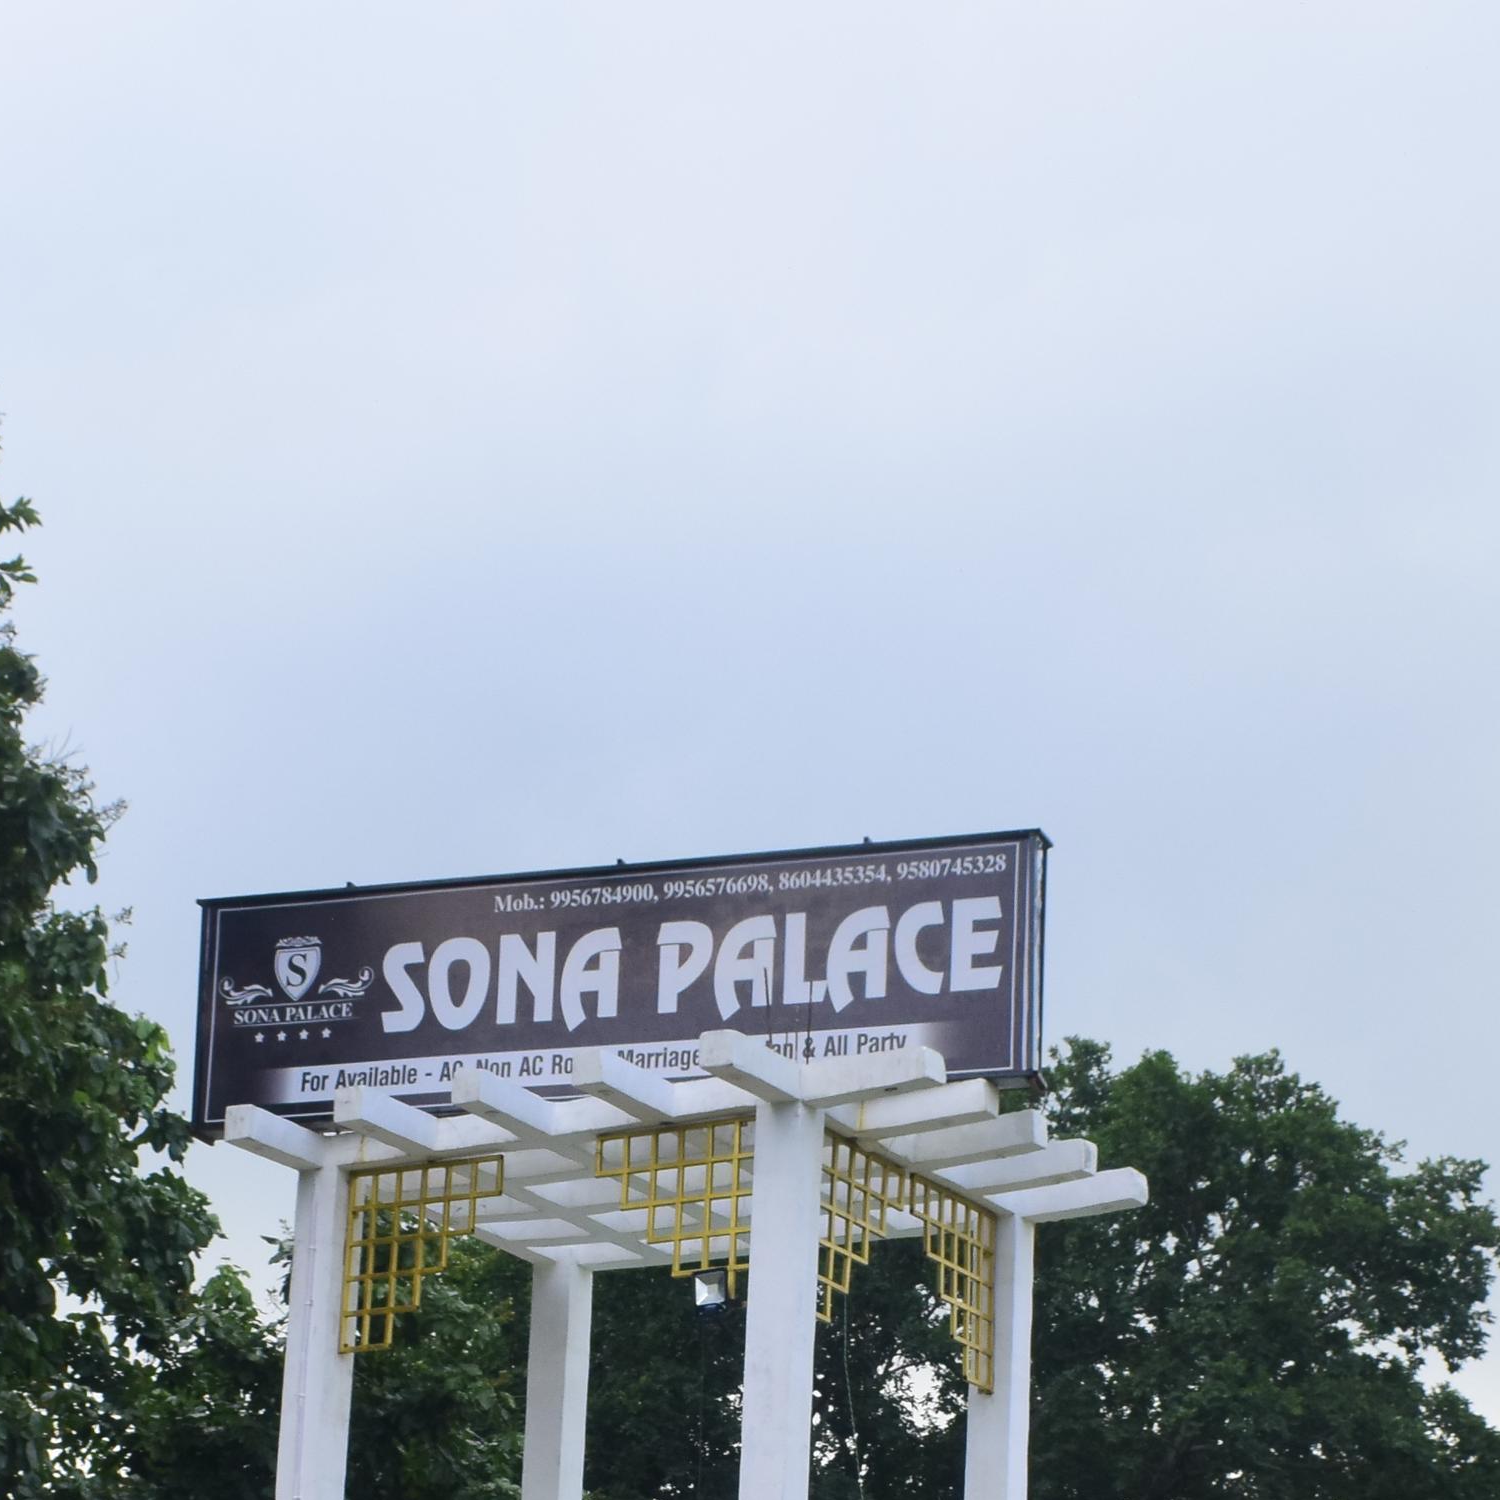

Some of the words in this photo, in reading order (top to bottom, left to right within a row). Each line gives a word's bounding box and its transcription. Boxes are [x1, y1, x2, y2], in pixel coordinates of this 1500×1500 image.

[494, 895, 545, 912] Mob.:
[550, 884, 659, 908] 9956784900,
[663, 873, 774, 899] 9956576698,
[779, 863, 892, 891] 8604435354,
[897, 854, 1007, 881] 9580745328
[286, 953, 308, 987] S
[381, 927, 623, 1034] SONA
[657, 896, 1003, 1022] PALACE
[234, 1008, 280, 1025] SONA
[285, 1002, 353, 1022] PALACE
[301, 1071, 329, 1092] For
[335, 1064, 417, 1090] Available
[519, 1055, 544, 1077] AC
[551, 1054, 574, 1075] Ro
[802, 1036, 816, 1058] &
[823, 1034, 849, 1057] All
